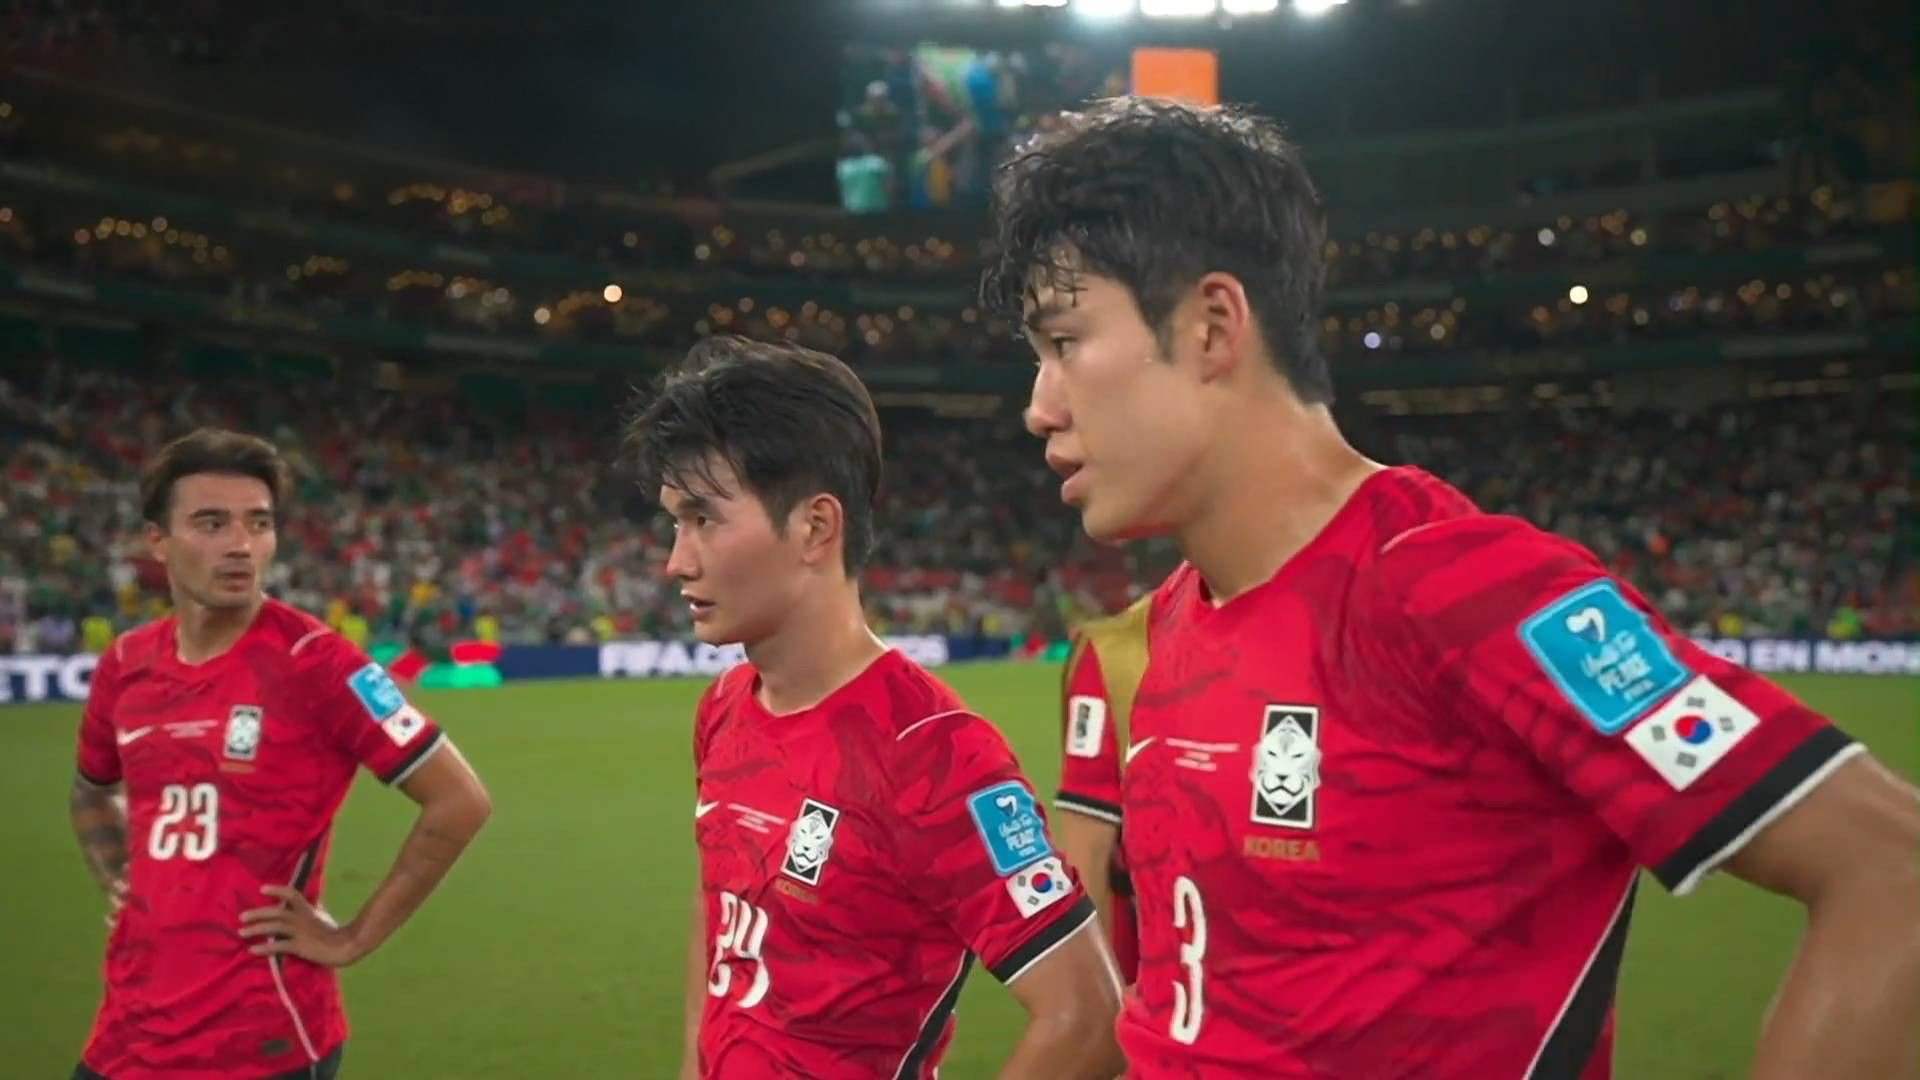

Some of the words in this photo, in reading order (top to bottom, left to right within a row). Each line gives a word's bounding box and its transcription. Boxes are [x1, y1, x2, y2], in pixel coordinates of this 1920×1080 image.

[1750, 638, 1808, 672] EN
[148, 783, 218, 861] 23
[1243, 835, 1321, 863] KOREA
[707, 890, 769, 1008] 24
[1169, 875, 1207, 1045] 3
